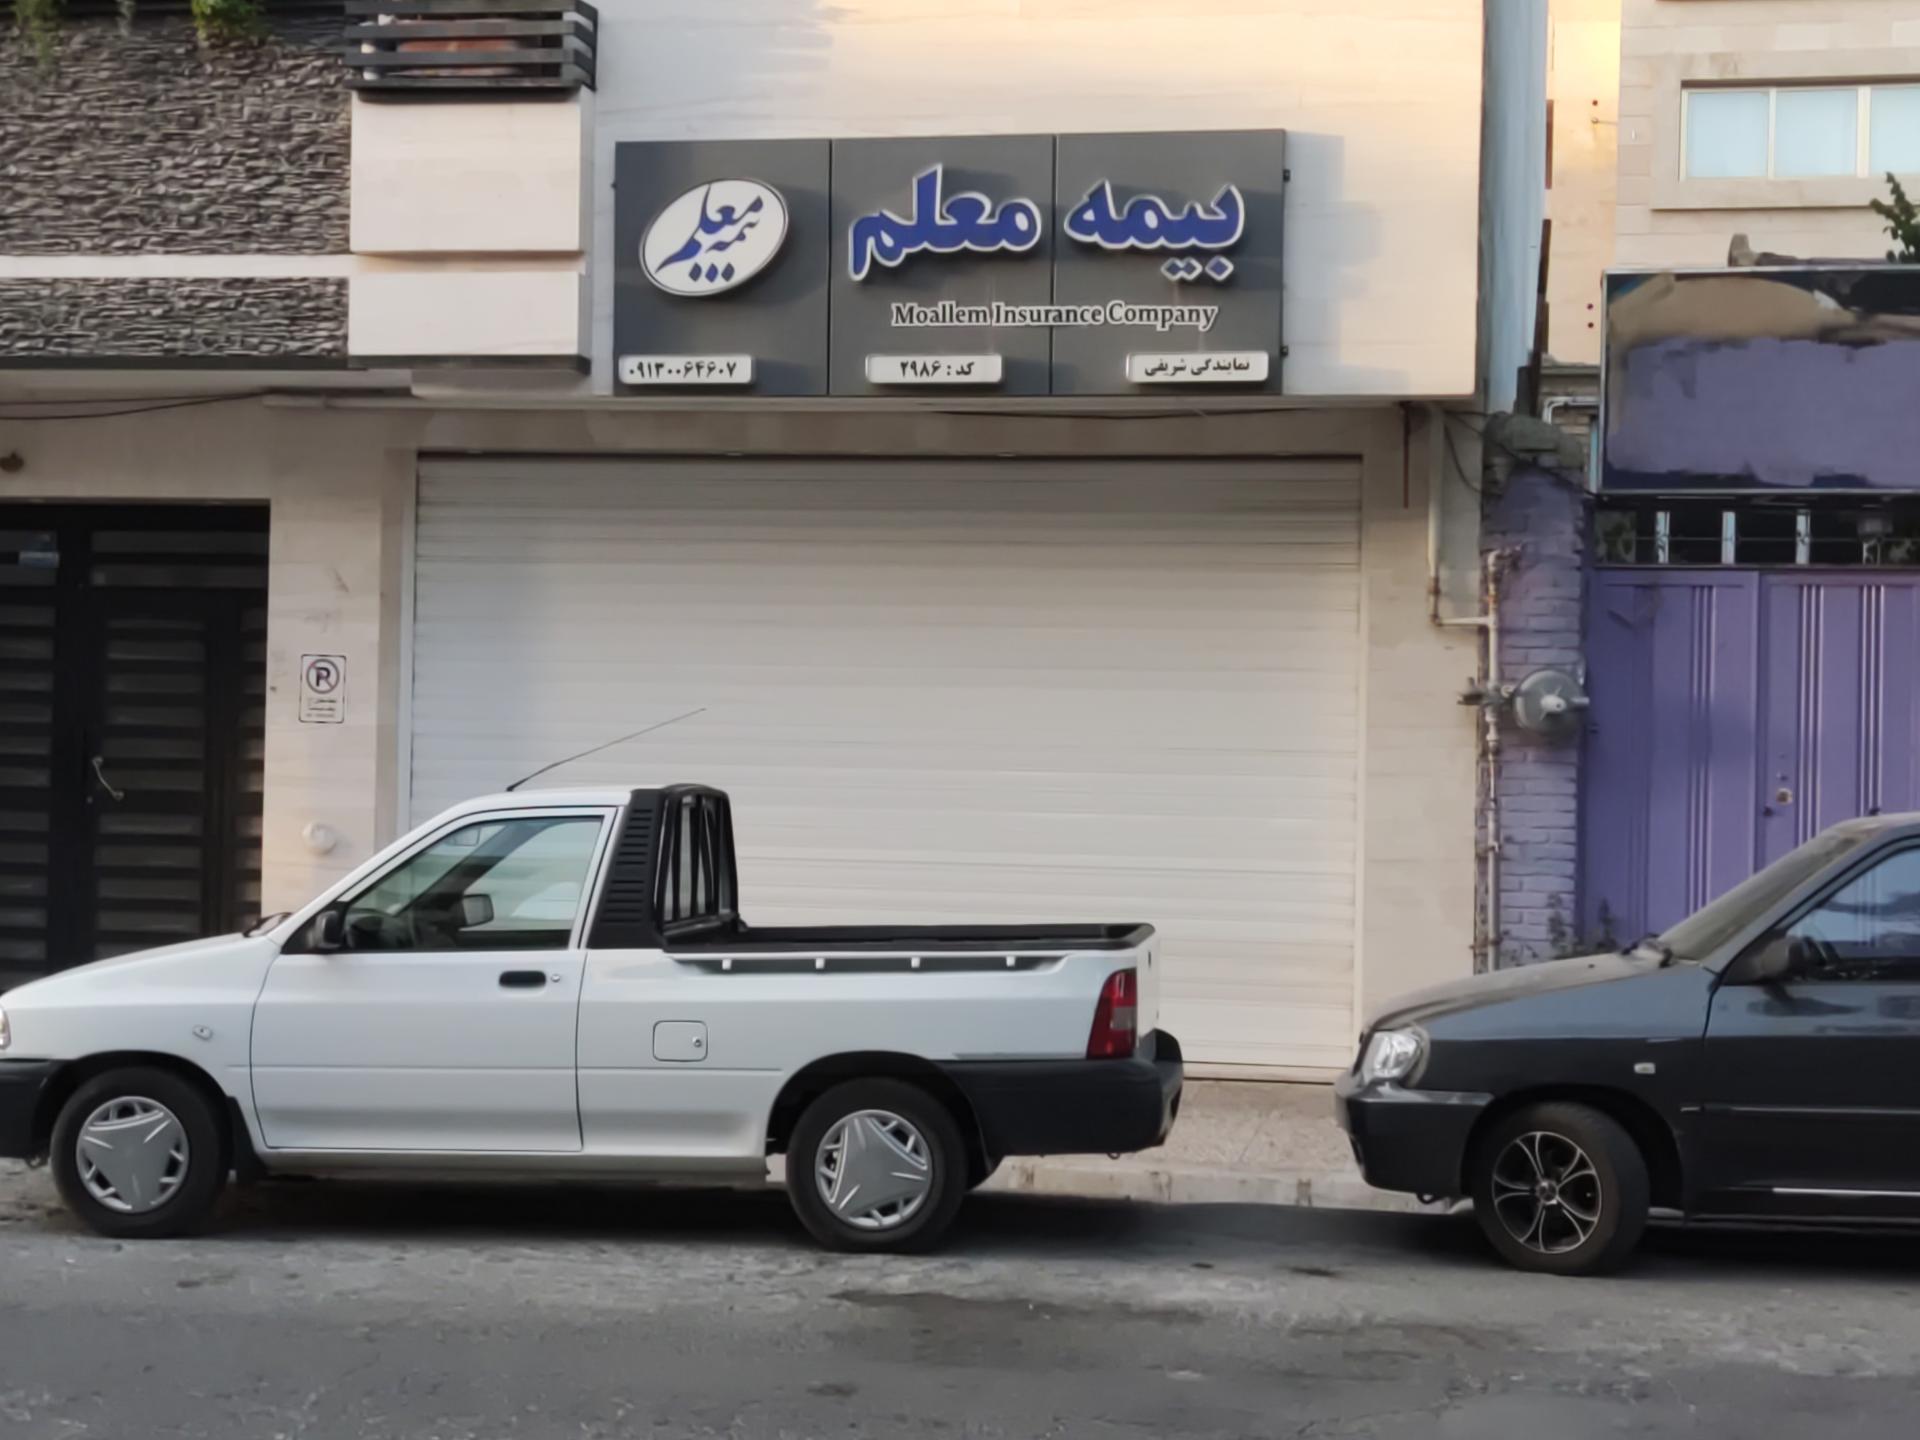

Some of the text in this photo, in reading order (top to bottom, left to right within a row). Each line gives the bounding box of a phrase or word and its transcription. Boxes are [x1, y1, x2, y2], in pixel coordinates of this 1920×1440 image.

[849, 163, 1245, 282] بیمه معلم
[891, 300, 1218, 332] Moallem Insurance Company
[900, 360, 942, 378] ۲۹۸۶
